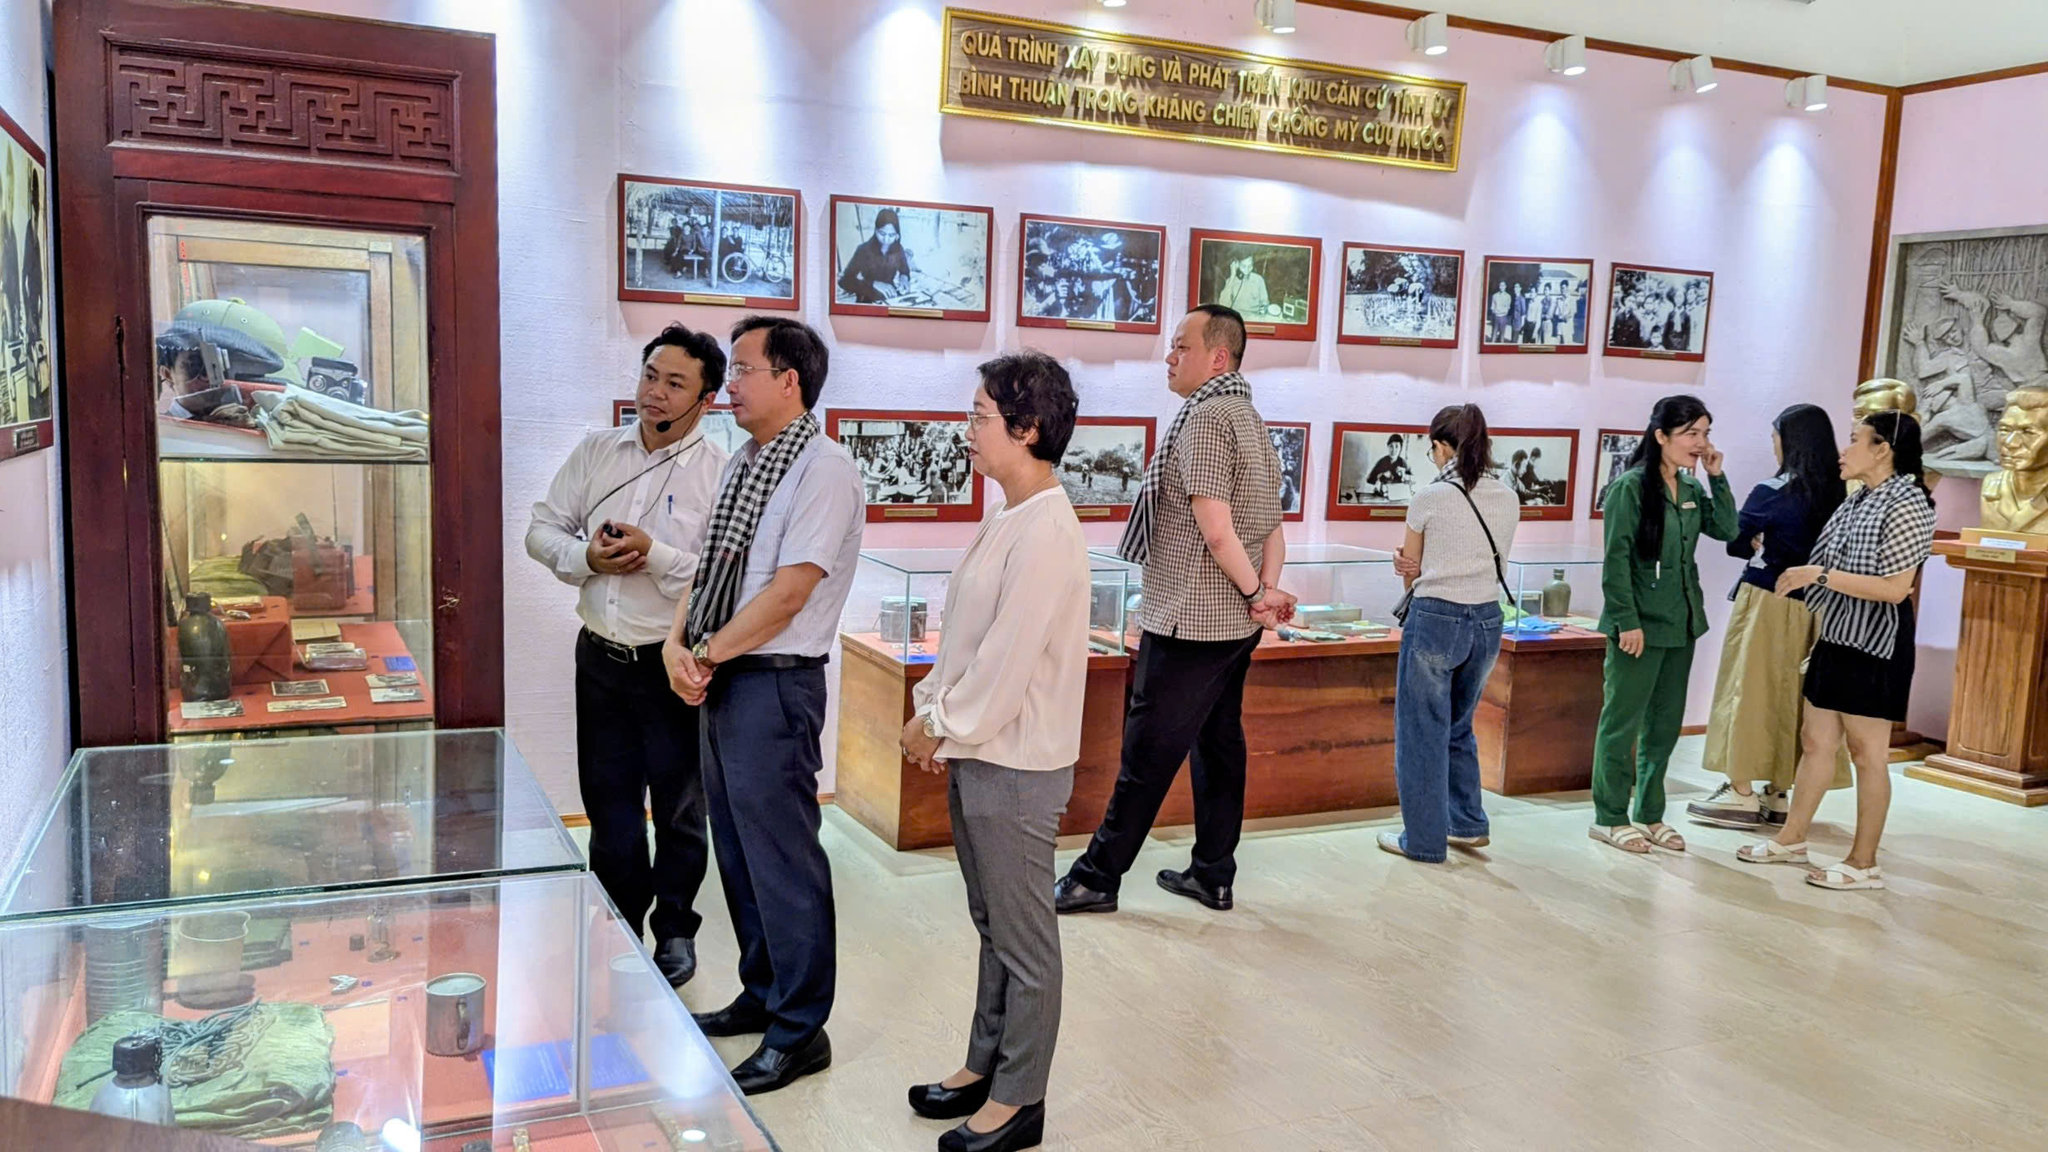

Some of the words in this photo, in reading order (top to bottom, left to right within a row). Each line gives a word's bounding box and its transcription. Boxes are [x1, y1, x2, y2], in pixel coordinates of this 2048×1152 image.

[960, 67, 1002, 98] BÌNH
[1009, 75, 1069, 109] THUẬN
[1076, 86, 1137, 114] TRONG
[1144, 93, 1206, 122] KHÁNG
[1213, 100, 1260, 129] CHIẾN
[1334, 115, 1359, 142] MỸ
[1400, 125, 1444, 151] NƯỚC
[961, 29, 1002, 59] QUÁ
[1007, 35, 1059, 67] TRÌNH
[1065, 42, 1099, 73] XÂY
[1106, 52, 1156, 80] DỰNG
[1161, 56, 1182, 83] VÀ
[1189, 62, 1231, 90] PHÁT
[1288, 77, 1321, 101] KHU
[1326, 80, 1360, 106] CĂN
[1365, 84, 1389, 110] CỨ
